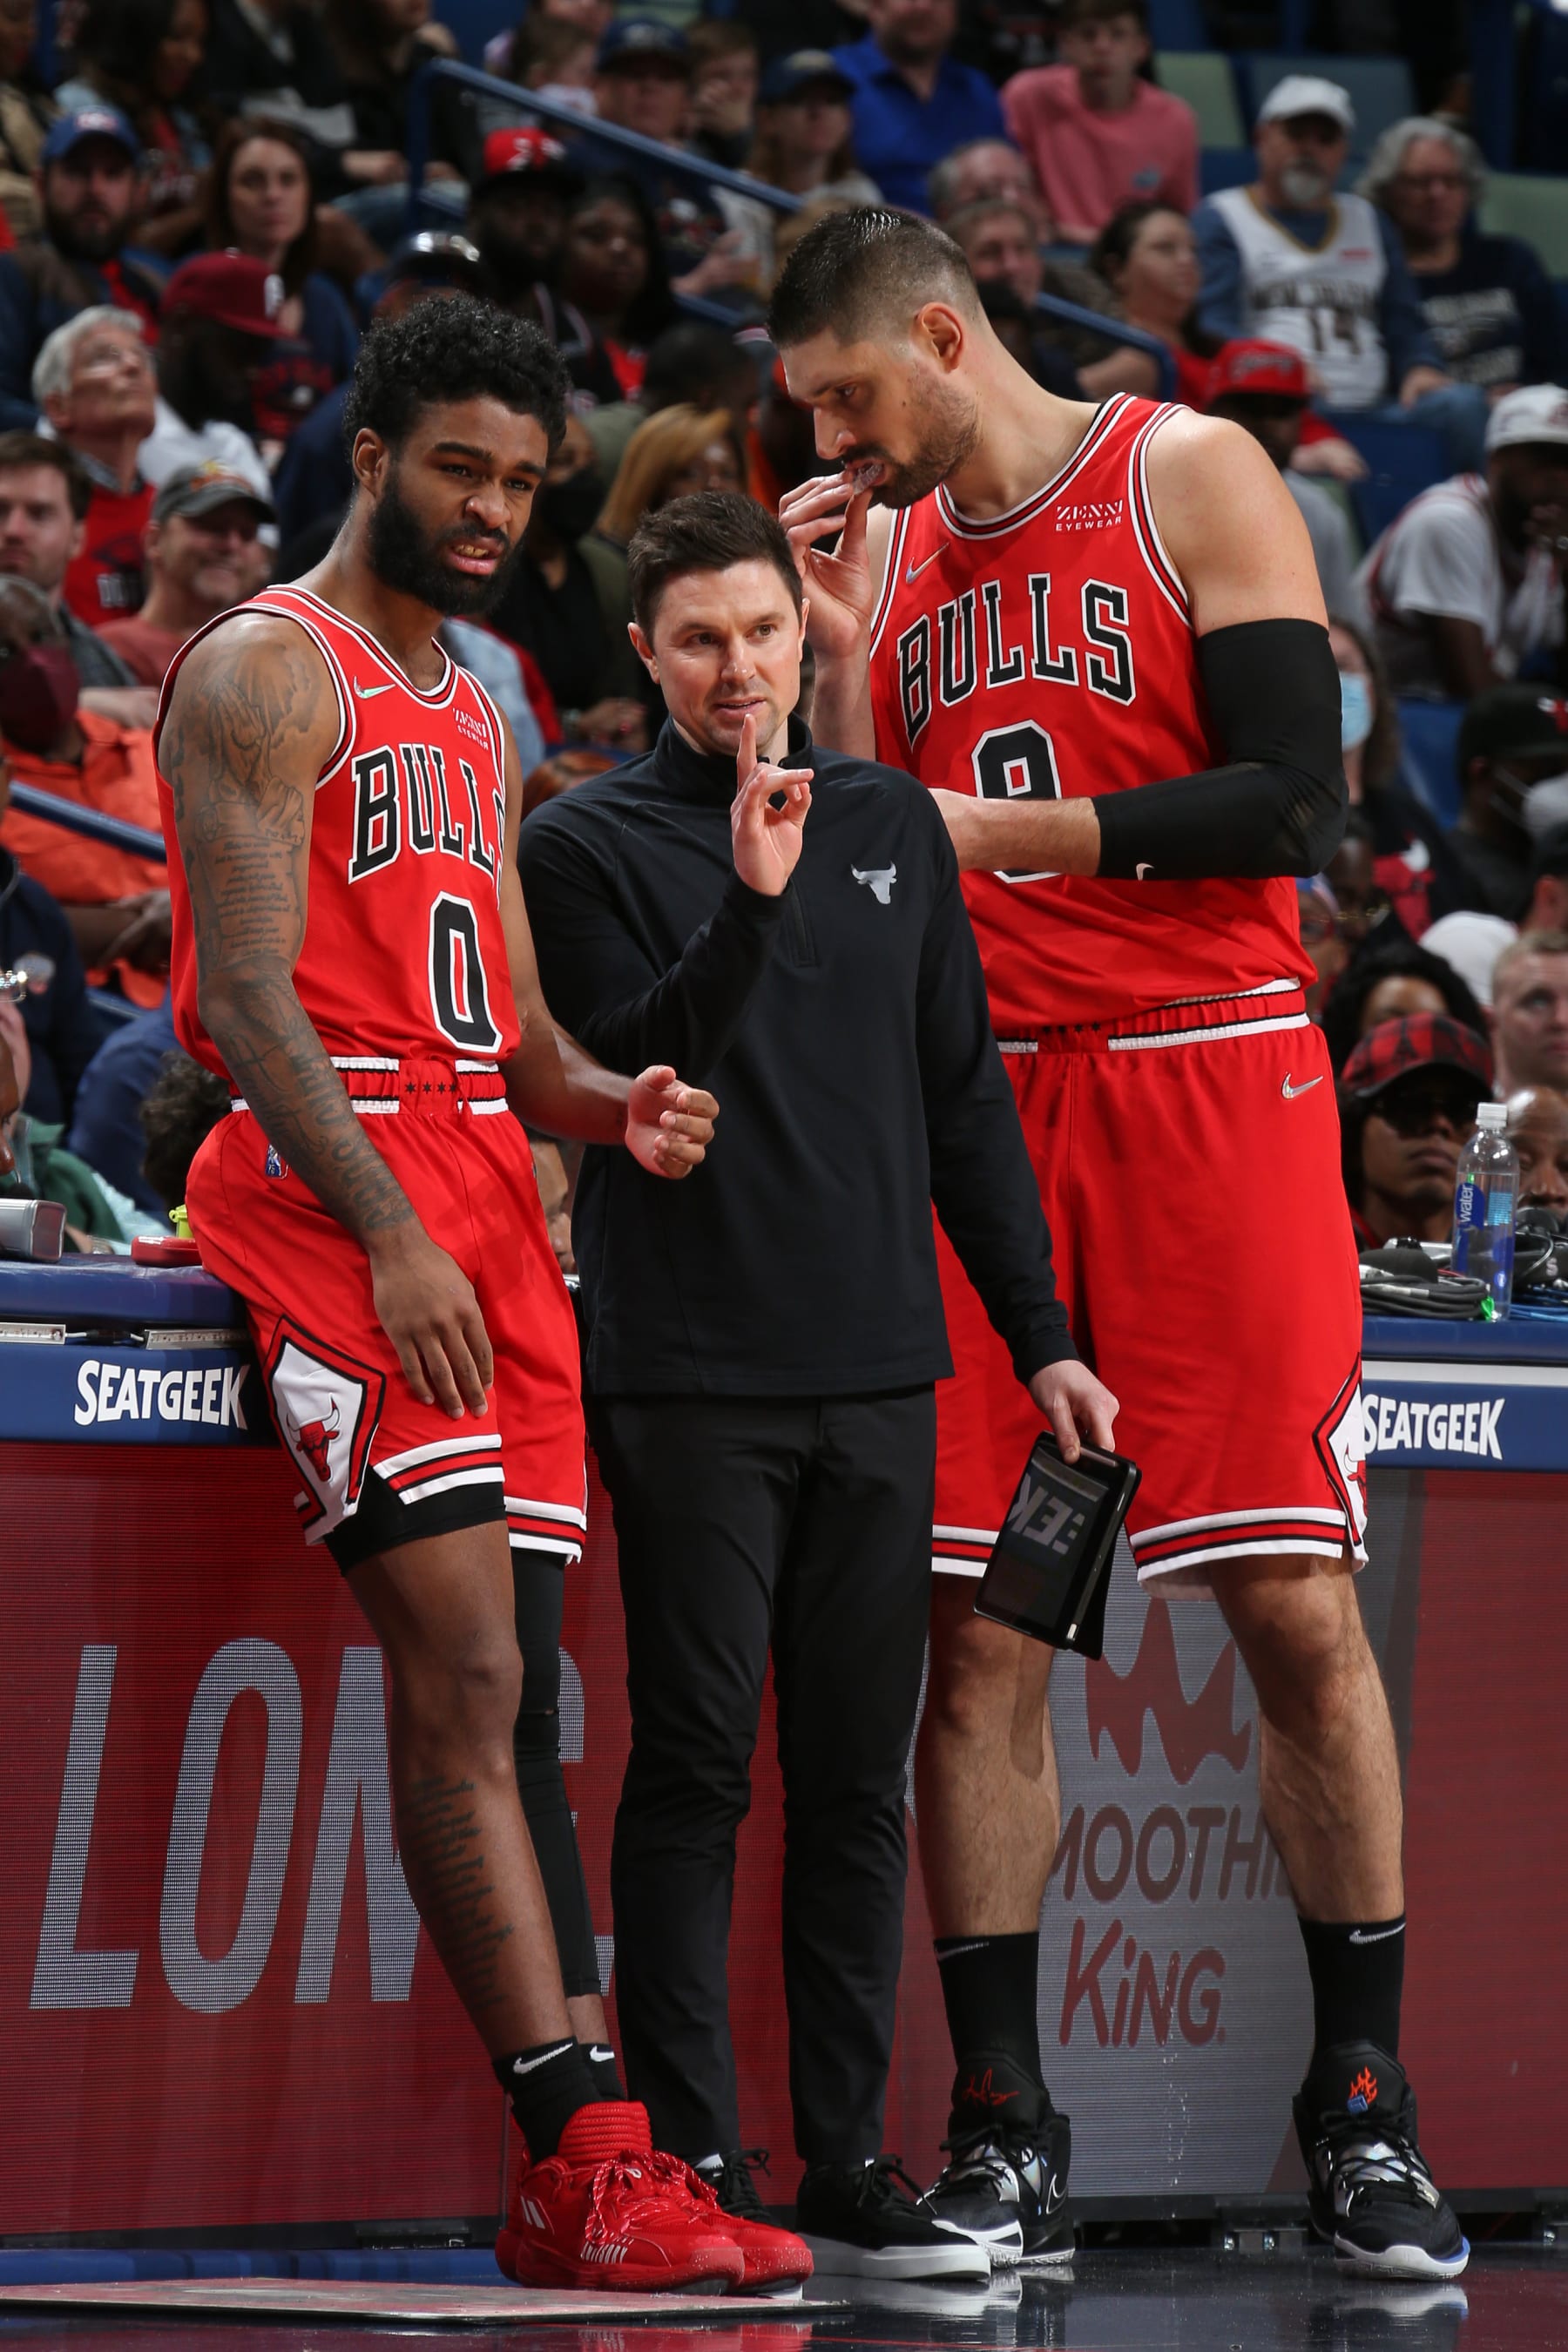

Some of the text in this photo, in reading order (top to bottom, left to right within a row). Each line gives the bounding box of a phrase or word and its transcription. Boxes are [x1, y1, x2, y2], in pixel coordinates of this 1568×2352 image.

[1056, 516, 1121, 531] EYEWEAR
[1057, 499, 1123, 520] ZENNI
[896, 572, 1136, 754] BULLS
[428, 890, 503, 1053] 0
[1459, 1184, 1474, 1222] water
[74, 1360, 250, 1430] SEATGEEK
[1362, 1394, 1505, 1460] SEATGEEK
[29, 1637, 585, 2014] LON
